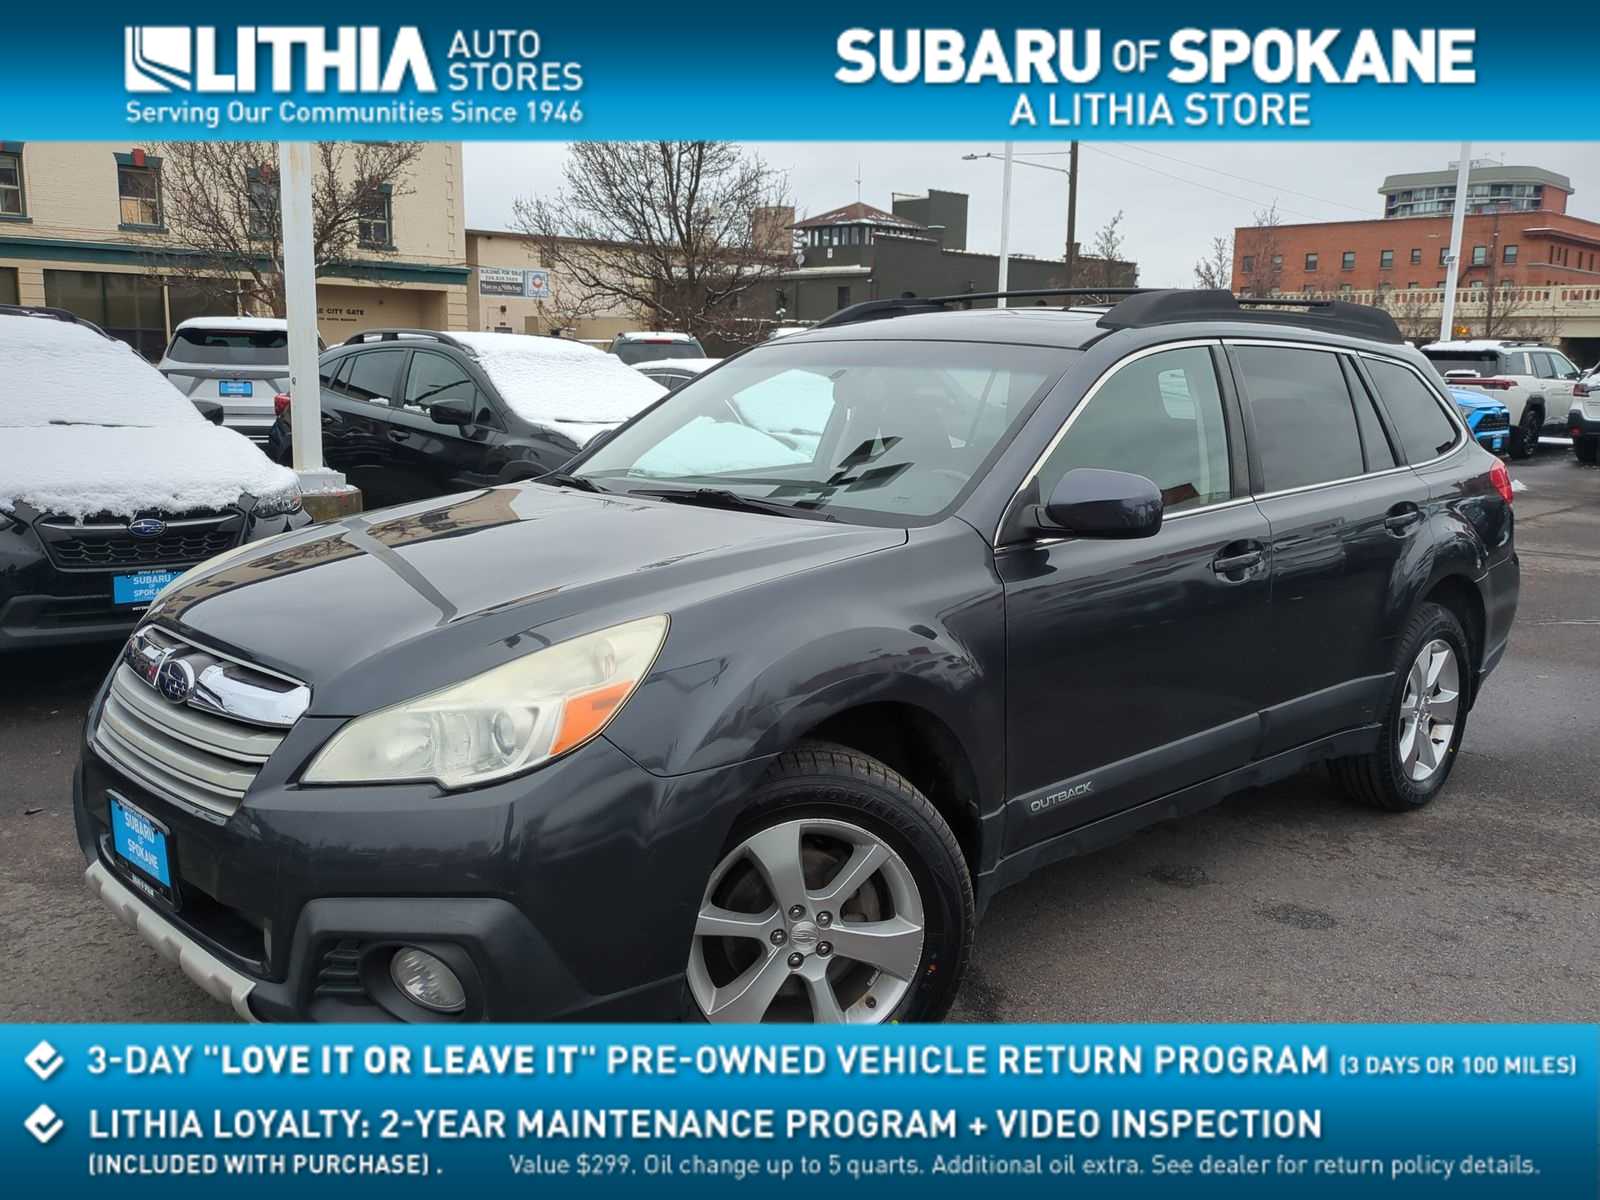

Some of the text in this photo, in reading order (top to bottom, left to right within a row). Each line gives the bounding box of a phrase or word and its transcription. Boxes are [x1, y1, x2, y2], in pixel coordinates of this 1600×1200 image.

[132, 574, 171, 585] SUBARU
[133, 587, 161, 598] SPOKA
[1030, 781, 1094, 811] OUTBACK
[124, 811, 156, 844] SUBARU
[127, 838, 159, 871] SPOKANE
